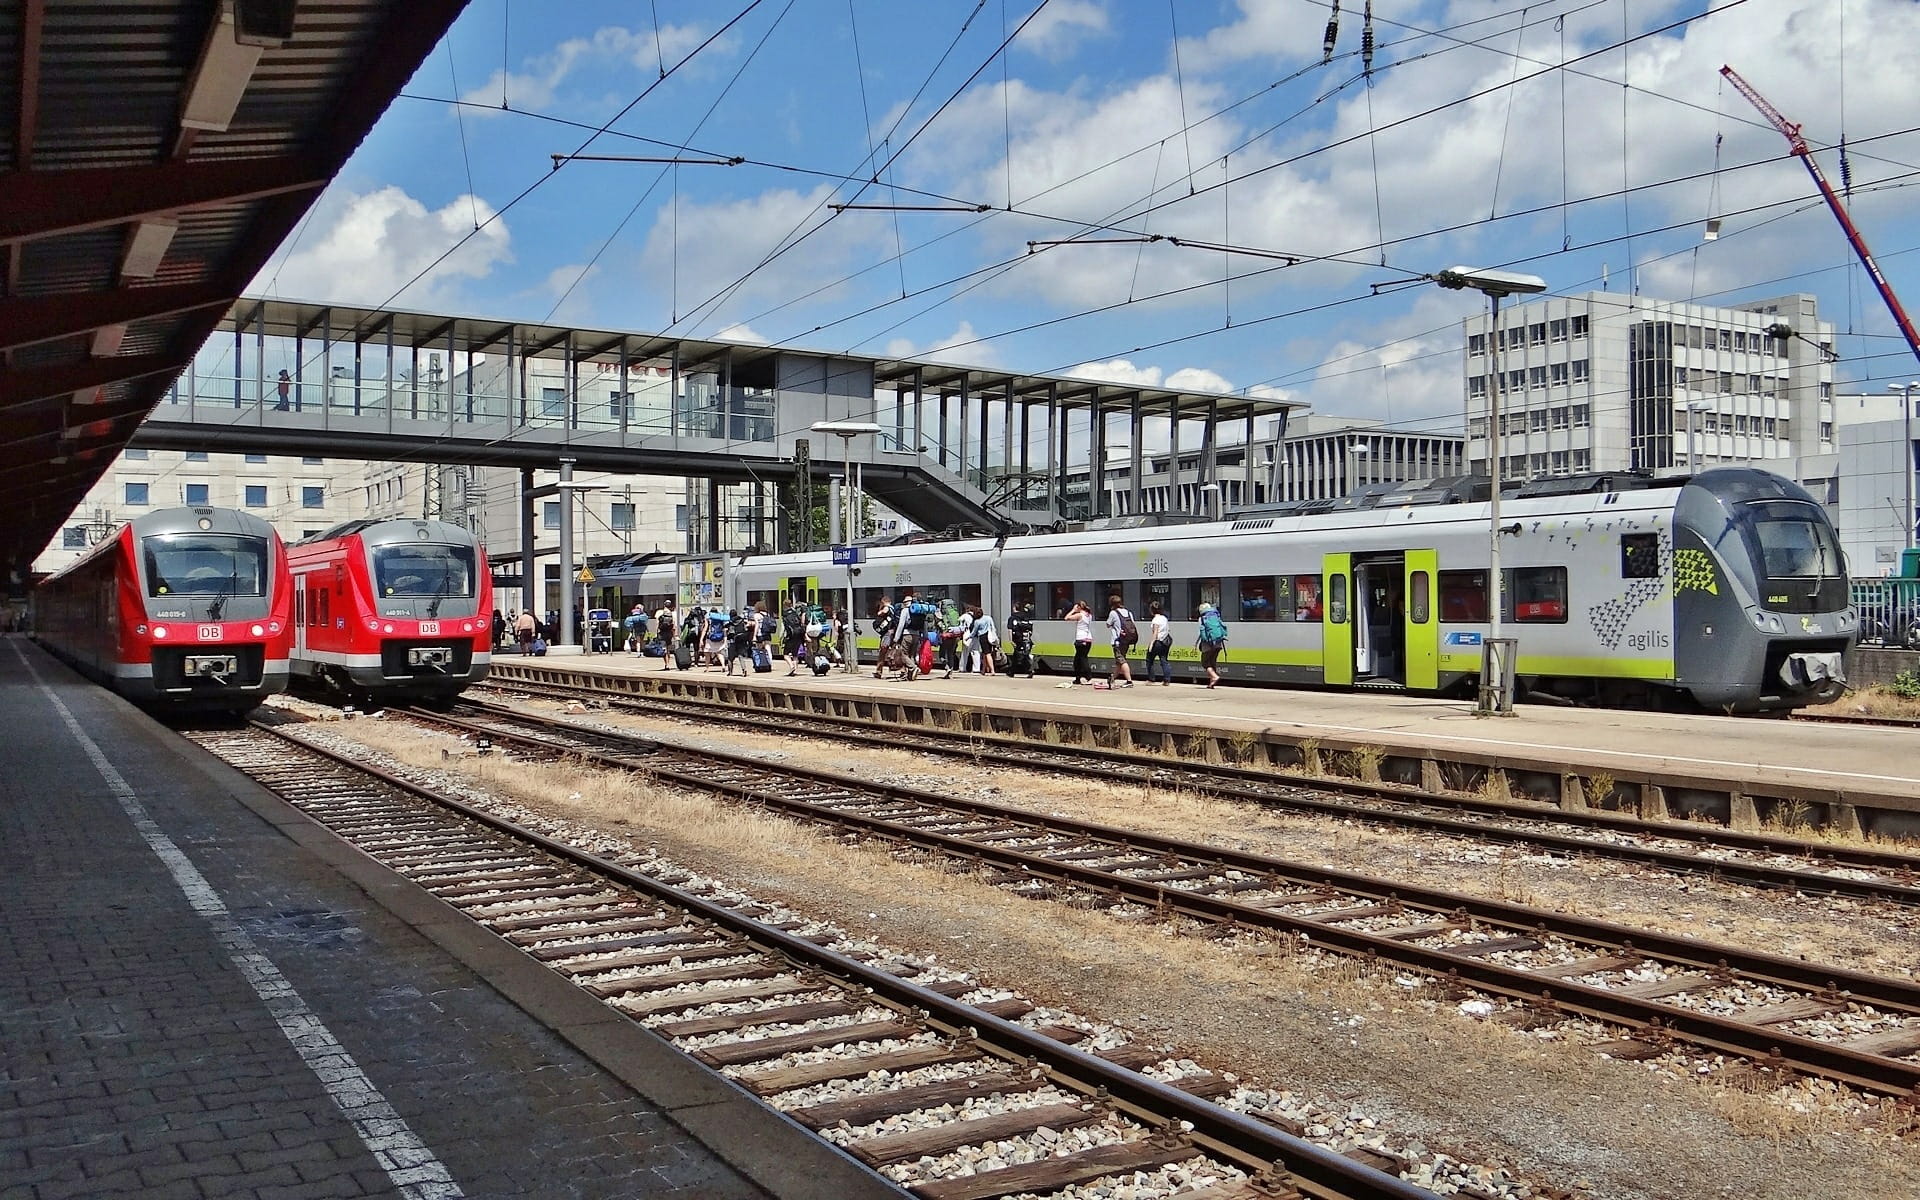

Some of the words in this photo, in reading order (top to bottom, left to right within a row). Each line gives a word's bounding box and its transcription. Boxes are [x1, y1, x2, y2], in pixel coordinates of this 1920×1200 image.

[1143, 558, 1169, 577] agilis
[896, 570, 912, 585] agilis
[1281, 578, 1288, 589] 2
[201, 627, 219, 638] DB
[422, 624, 437, 633] DB
[1628, 630, 1669, 651] agilis
